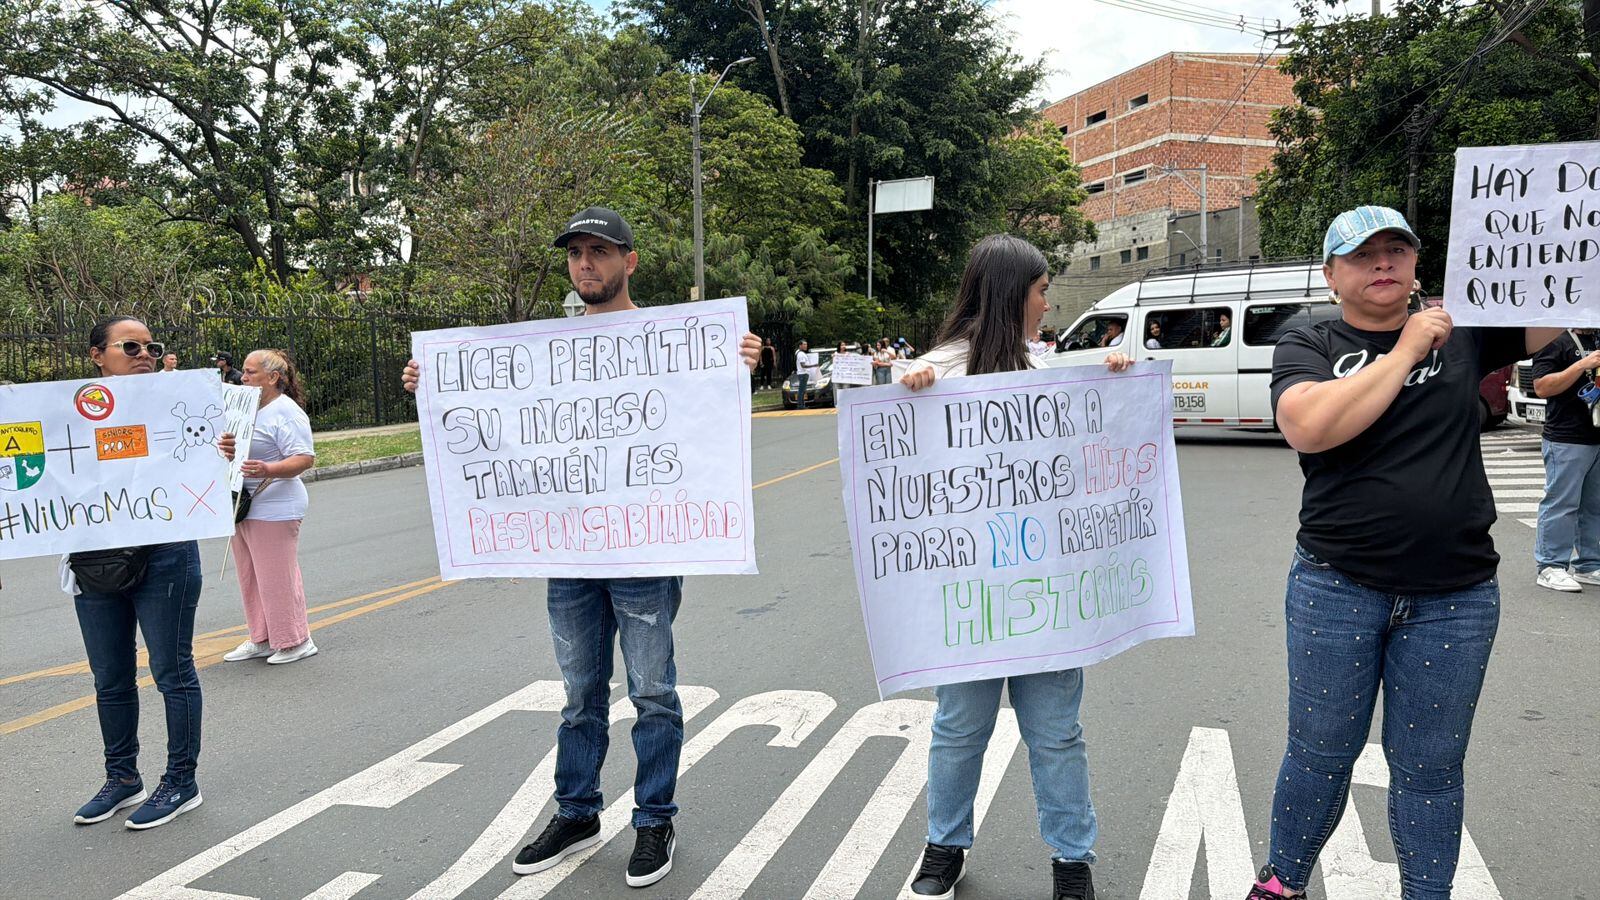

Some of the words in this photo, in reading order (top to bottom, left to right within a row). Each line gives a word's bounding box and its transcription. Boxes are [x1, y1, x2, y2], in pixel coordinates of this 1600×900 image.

[1471, 163, 1534, 202] HAY
[1485, 209, 1546, 239] QUE
[1466, 239, 1600, 270] ENTIEND
[1467, 277, 1527, 310] QUE
[1541, 275, 1583, 308] SE
[5, 435, 21, 451] A
[443, 407, 502, 455] SU
[520, 389, 668, 444] INGRESO
[861, 402, 917, 463] EN
[945, 391, 1075, 448] HONOR
[1085, 388, 1103, 433] A
[463, 446, 607, 499] TAMBIÉN
[626, 443, 683, 487] ES
[867, 452, 1075, 523] NUESTROS
[872, 527, 976, 579] PARA
[987, 511, 1046, 568] NO
